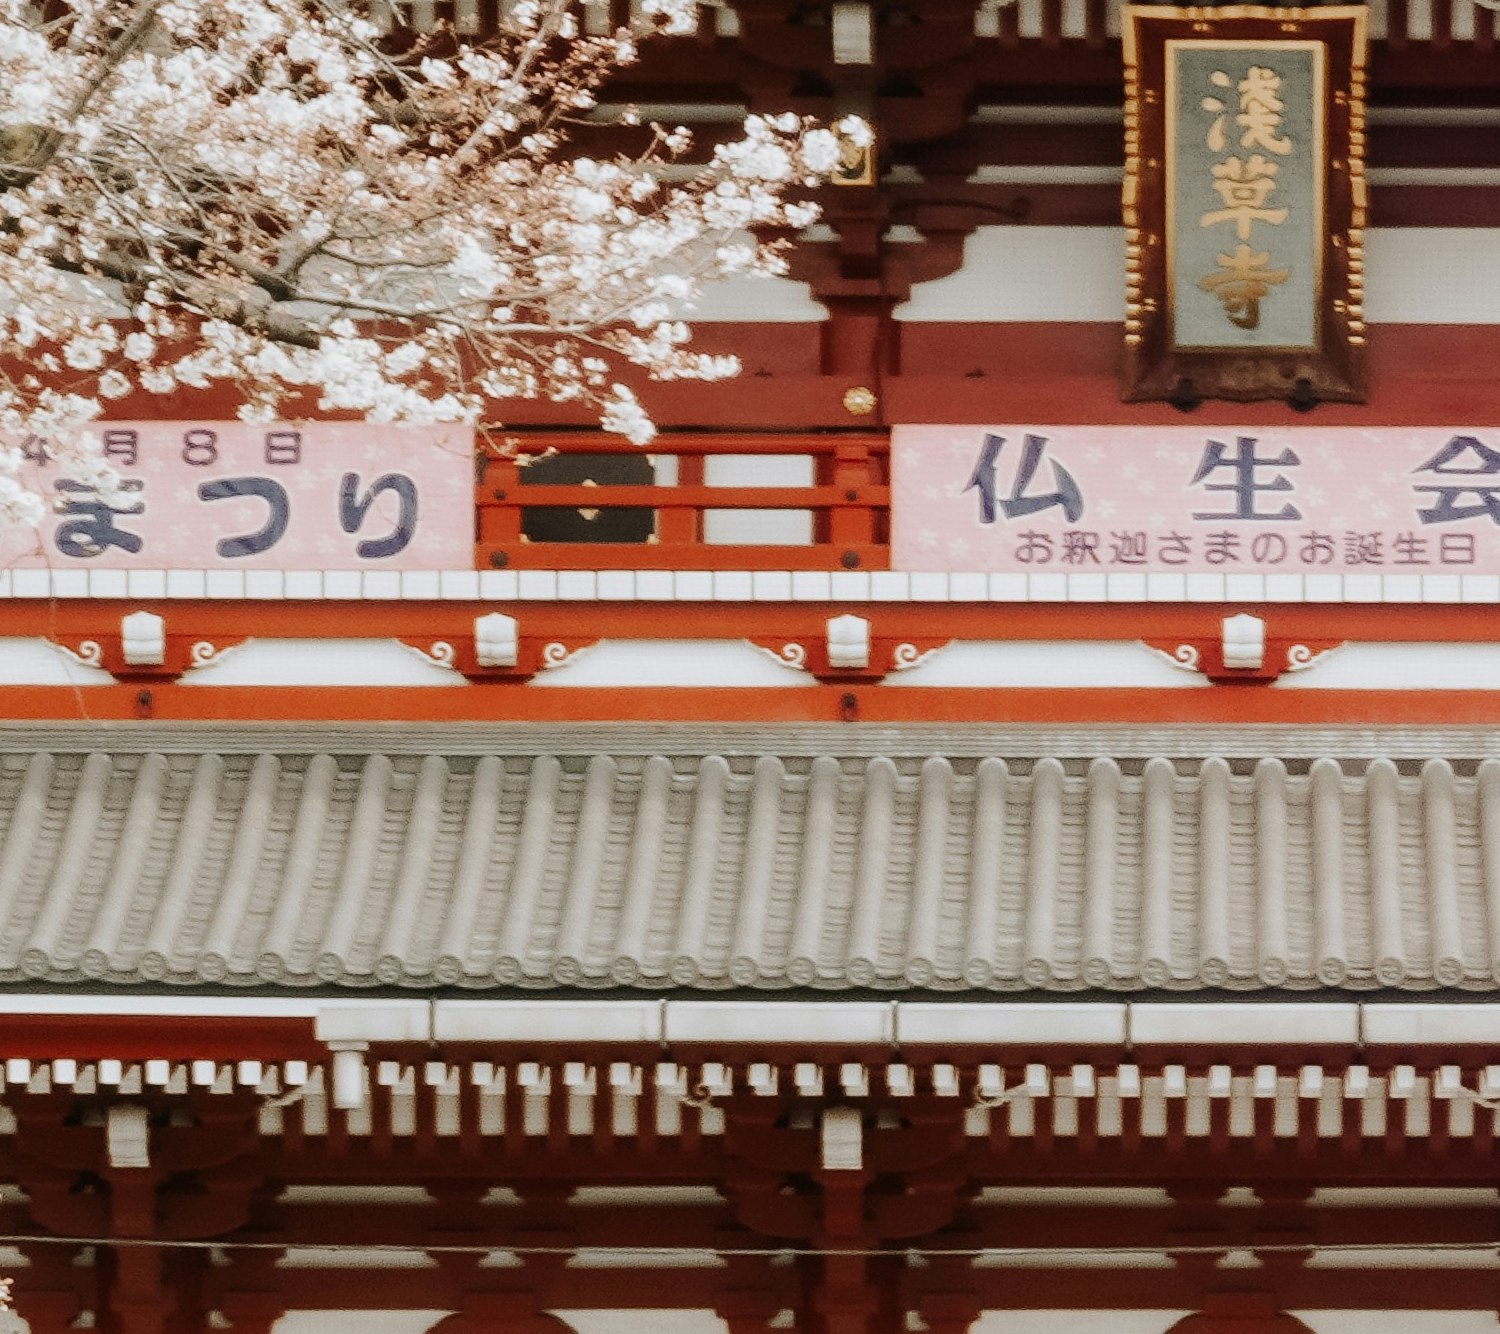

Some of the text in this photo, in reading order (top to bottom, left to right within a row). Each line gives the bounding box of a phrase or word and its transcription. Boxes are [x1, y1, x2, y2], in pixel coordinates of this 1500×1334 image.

[1014, 530, 1477, 566] お釈迦さまのお誕生日
